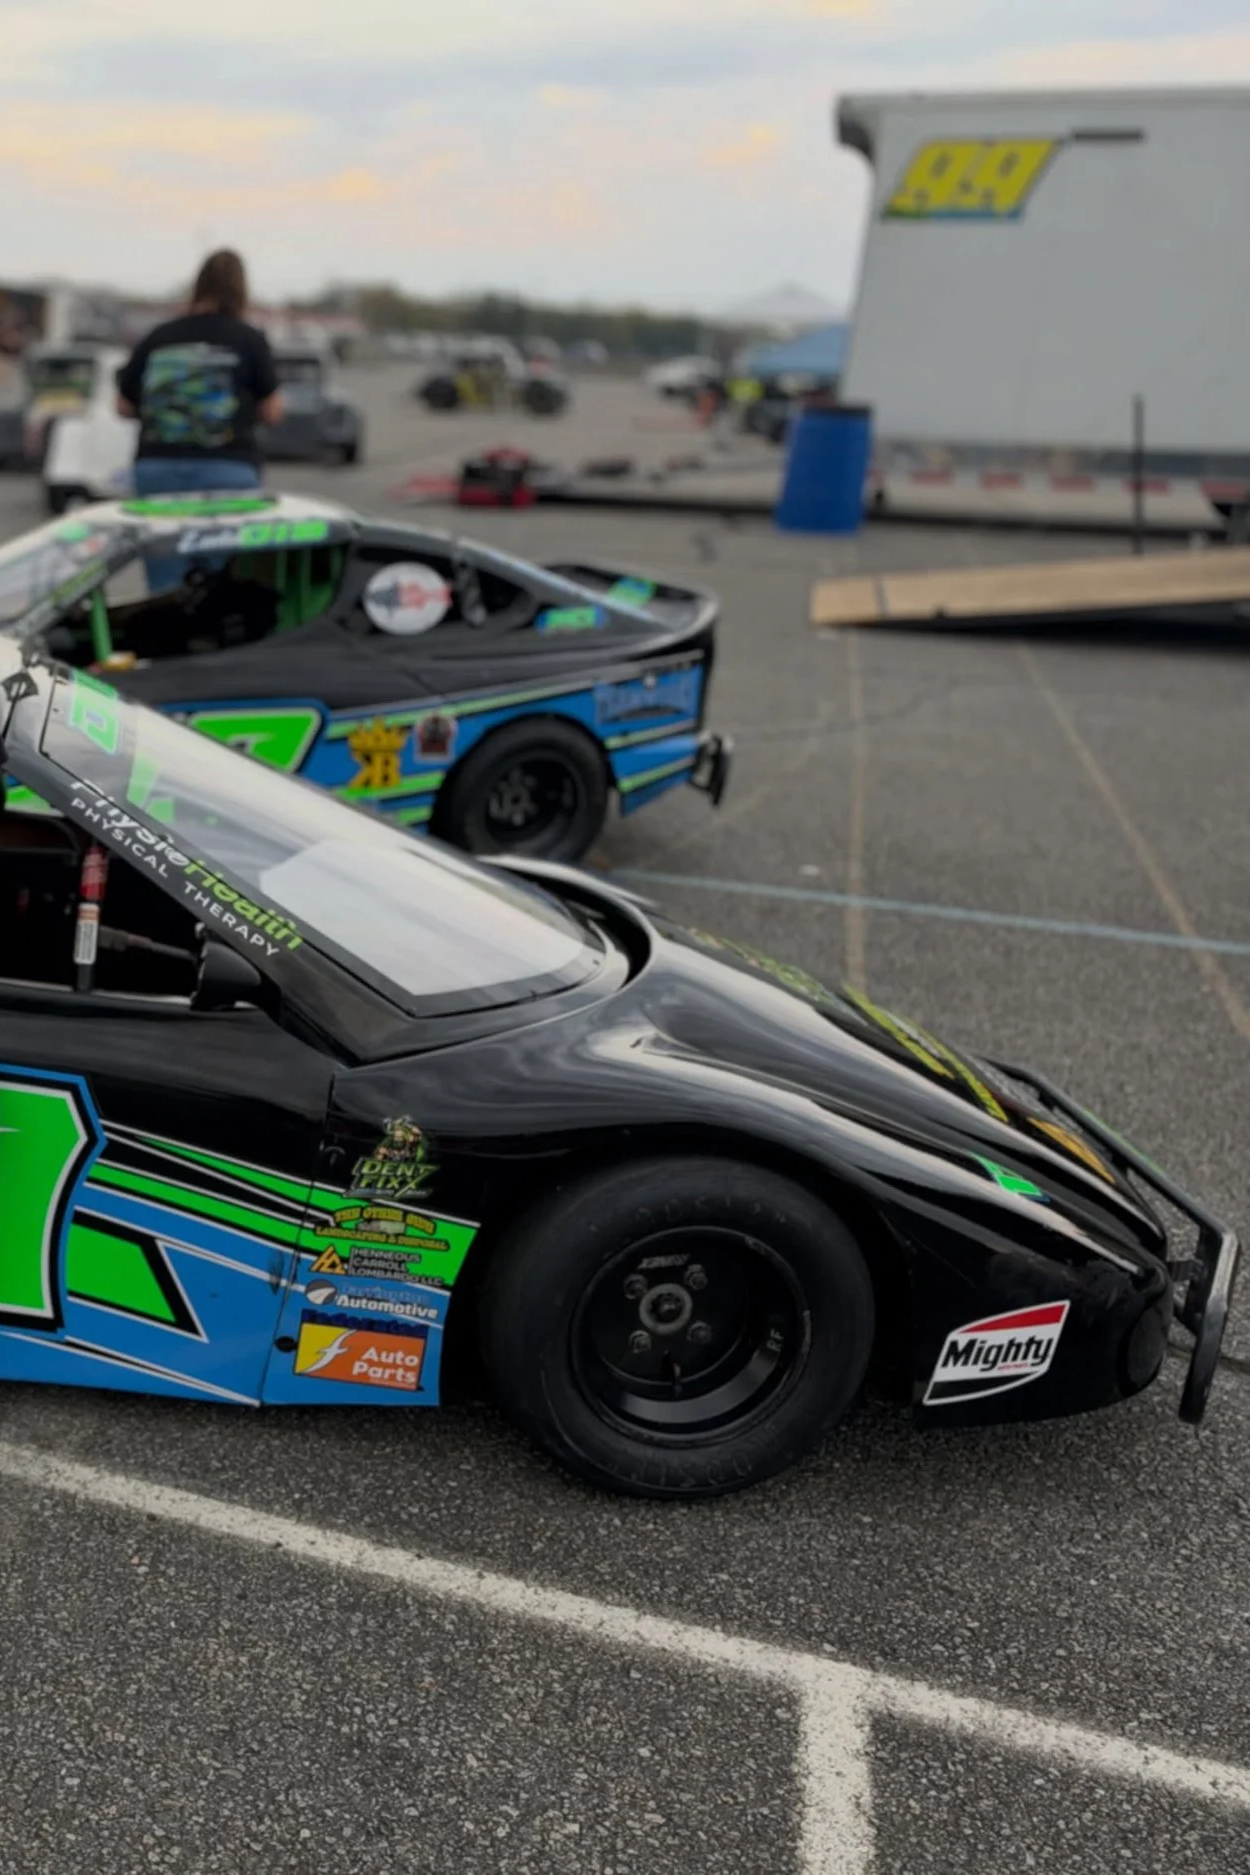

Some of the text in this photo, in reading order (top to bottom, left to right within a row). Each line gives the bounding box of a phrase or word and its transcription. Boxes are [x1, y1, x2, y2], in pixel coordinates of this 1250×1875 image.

[70, 797, 170, 878] PHYSICAL
[183, 880, 280, 957] THERAPY
[362, 1160, 442, 1176] DENT
[353, 1257, 408, 1273] CARROLL
[336, 1294, 438, 1320] Automotive
[360, 1346, 420, 1367] Auto
[940, 1335, 1054, 1372] Mighty
[352, 1360, 418, 1385] Parts
